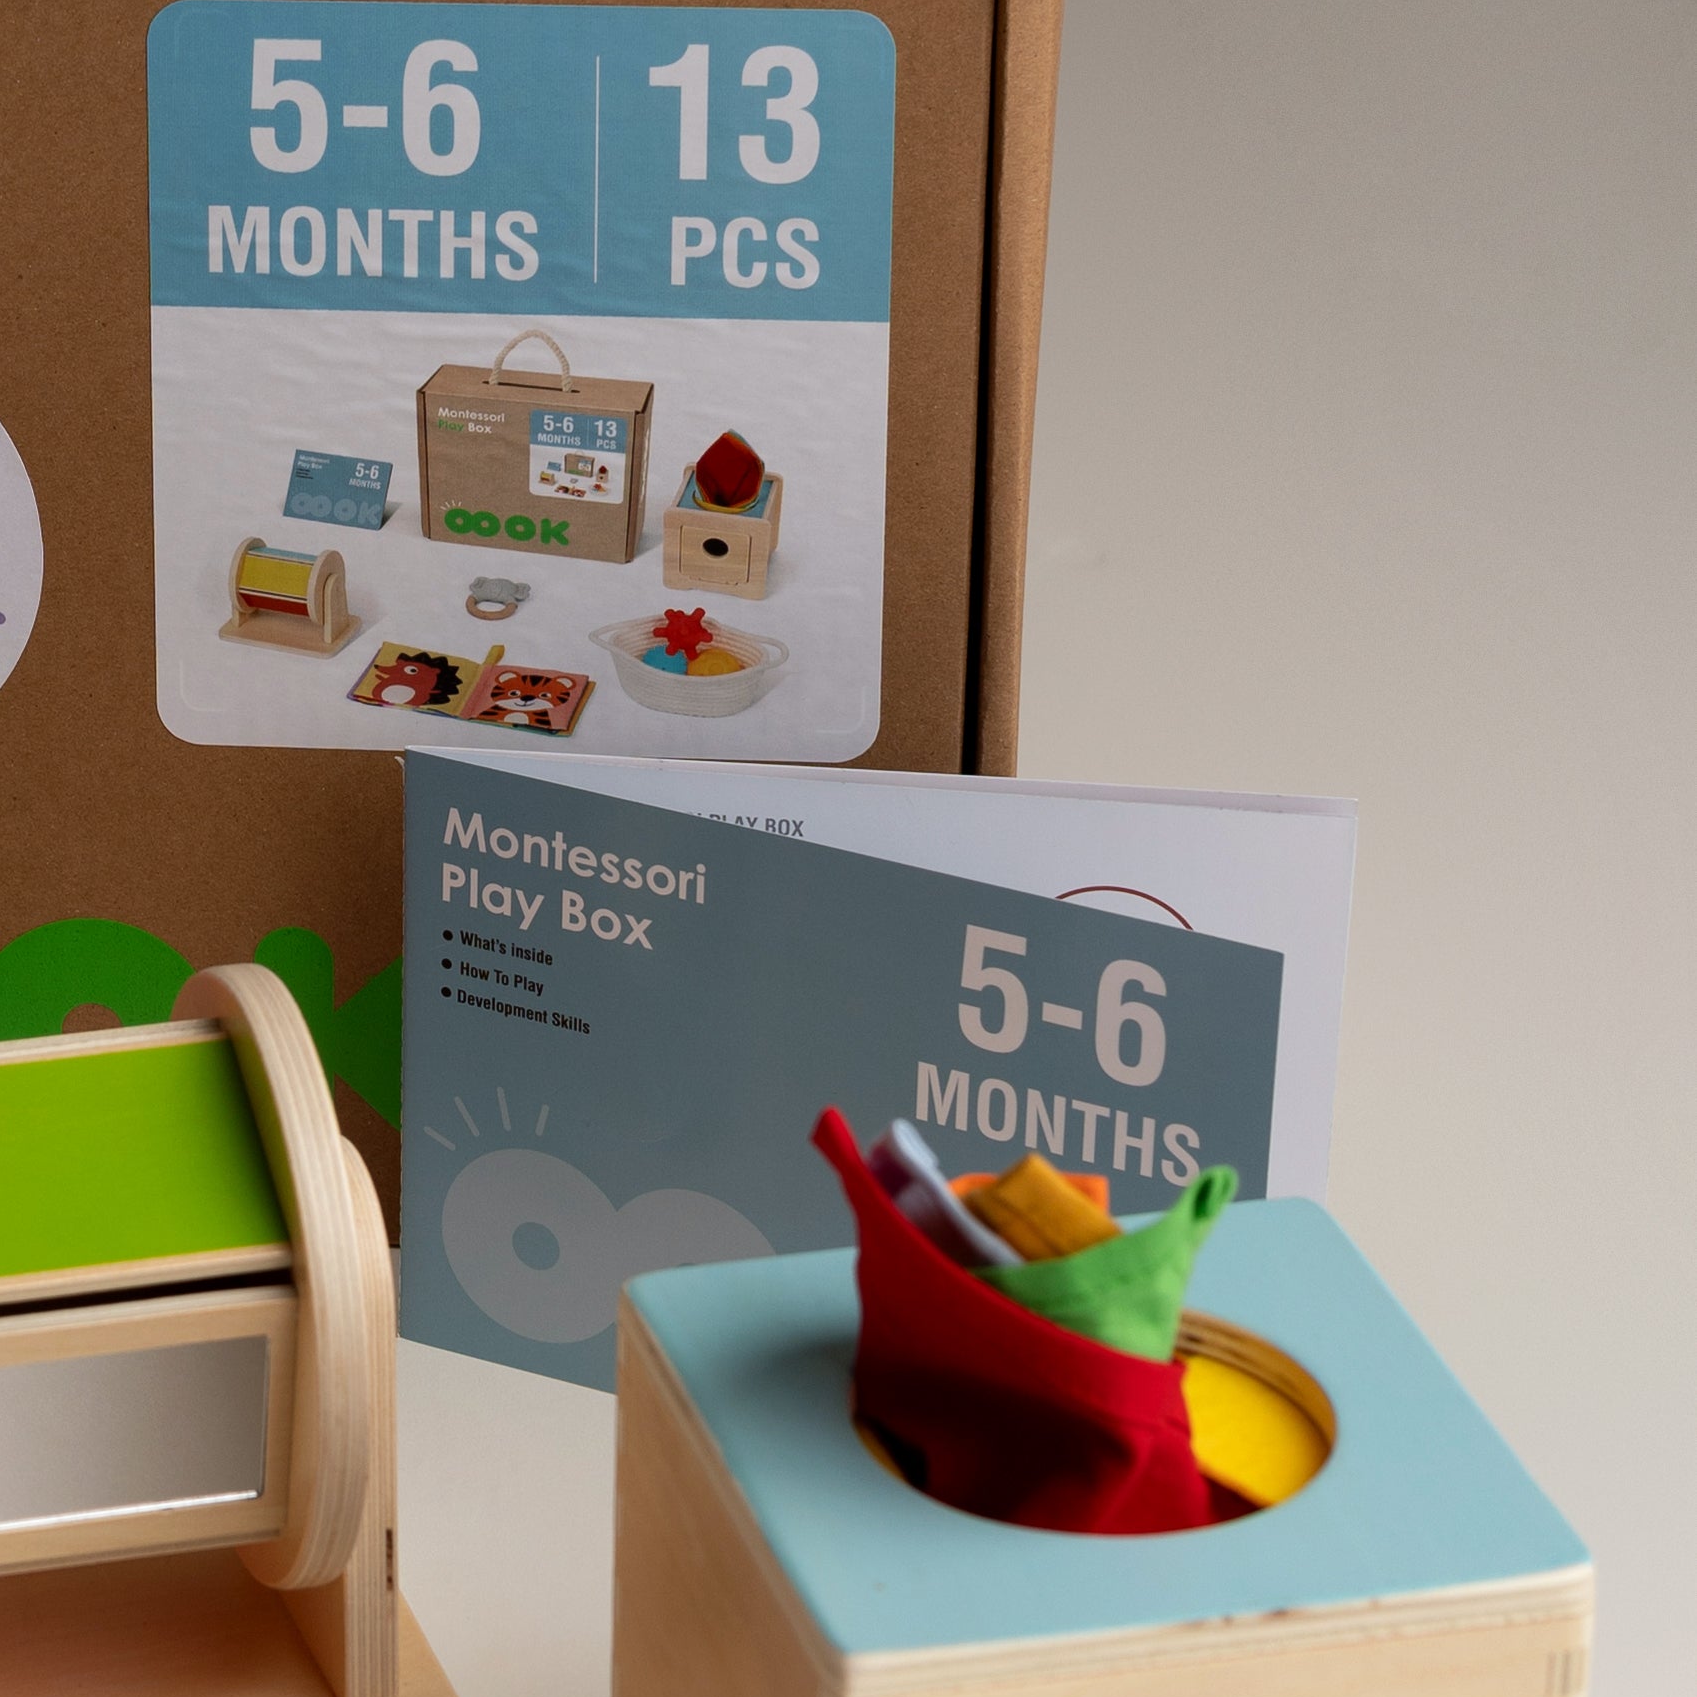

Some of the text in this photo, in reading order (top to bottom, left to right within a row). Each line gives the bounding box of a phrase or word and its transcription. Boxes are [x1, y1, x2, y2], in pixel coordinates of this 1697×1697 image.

[250, 38, 481, 177] 5-6
[649, 44, 821, 184] 13
[208, 205, 540, 282] MONTHS
[670, 216, 821, 290] PCS
[437, 419, 492, 434] Play Box
[438, 407, 505, 422] Montessori
[543, 414, 574, 433] 5-6
[594, 419, 617, 438] 13
[537, 432, 581, 446] MONTHS
[596, 439, 617, 450] PCS
[349, 478, 382, 490] MONTHS
[355, 463, 380, 480] 5-6
[765, 817, 805, 838] BOX
[443, 807, 707, 905] Montessori
[442, 862, 653, 950] Play Box
[460, 930, 553, 966] What's inside
[460, 961, 544, 997] How To Play
[457, 989, 590, 1034] Development Skills
[958, 924, 1167, 1087] 5-6
[915, 1061, 1201, 1188] MONTHS
